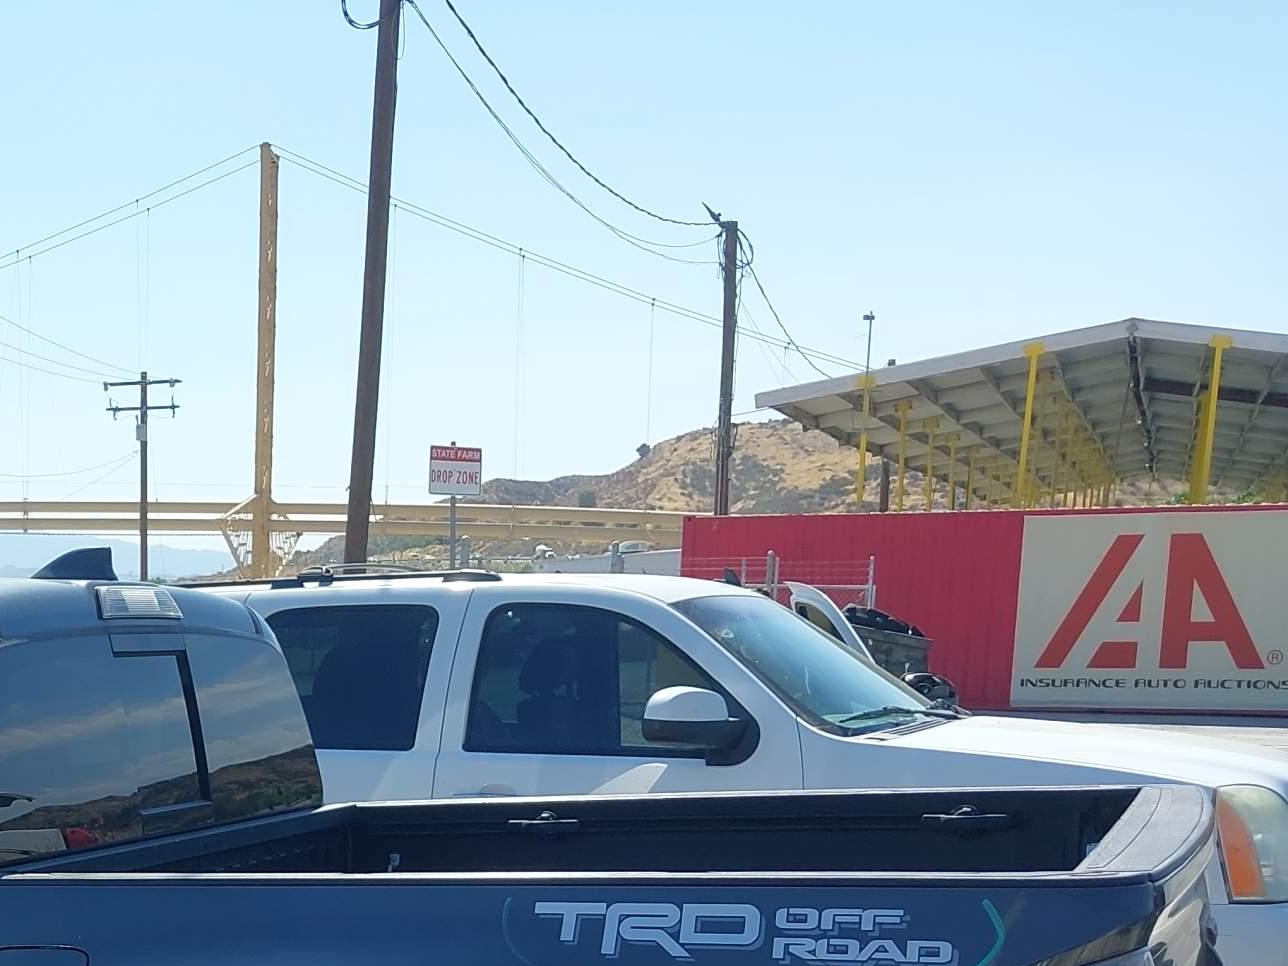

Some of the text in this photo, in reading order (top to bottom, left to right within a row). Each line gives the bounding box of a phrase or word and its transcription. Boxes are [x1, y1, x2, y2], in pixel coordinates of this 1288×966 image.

[432, 448, 480, 460] STATE FARM
[431, 468, 479, 485] DROP ZONE
[1020, 677, 1126, 689] INSURANCE
[1134, 678, 1187, 690] AUTO
[535, 902, 911, 961] TRD OFF
